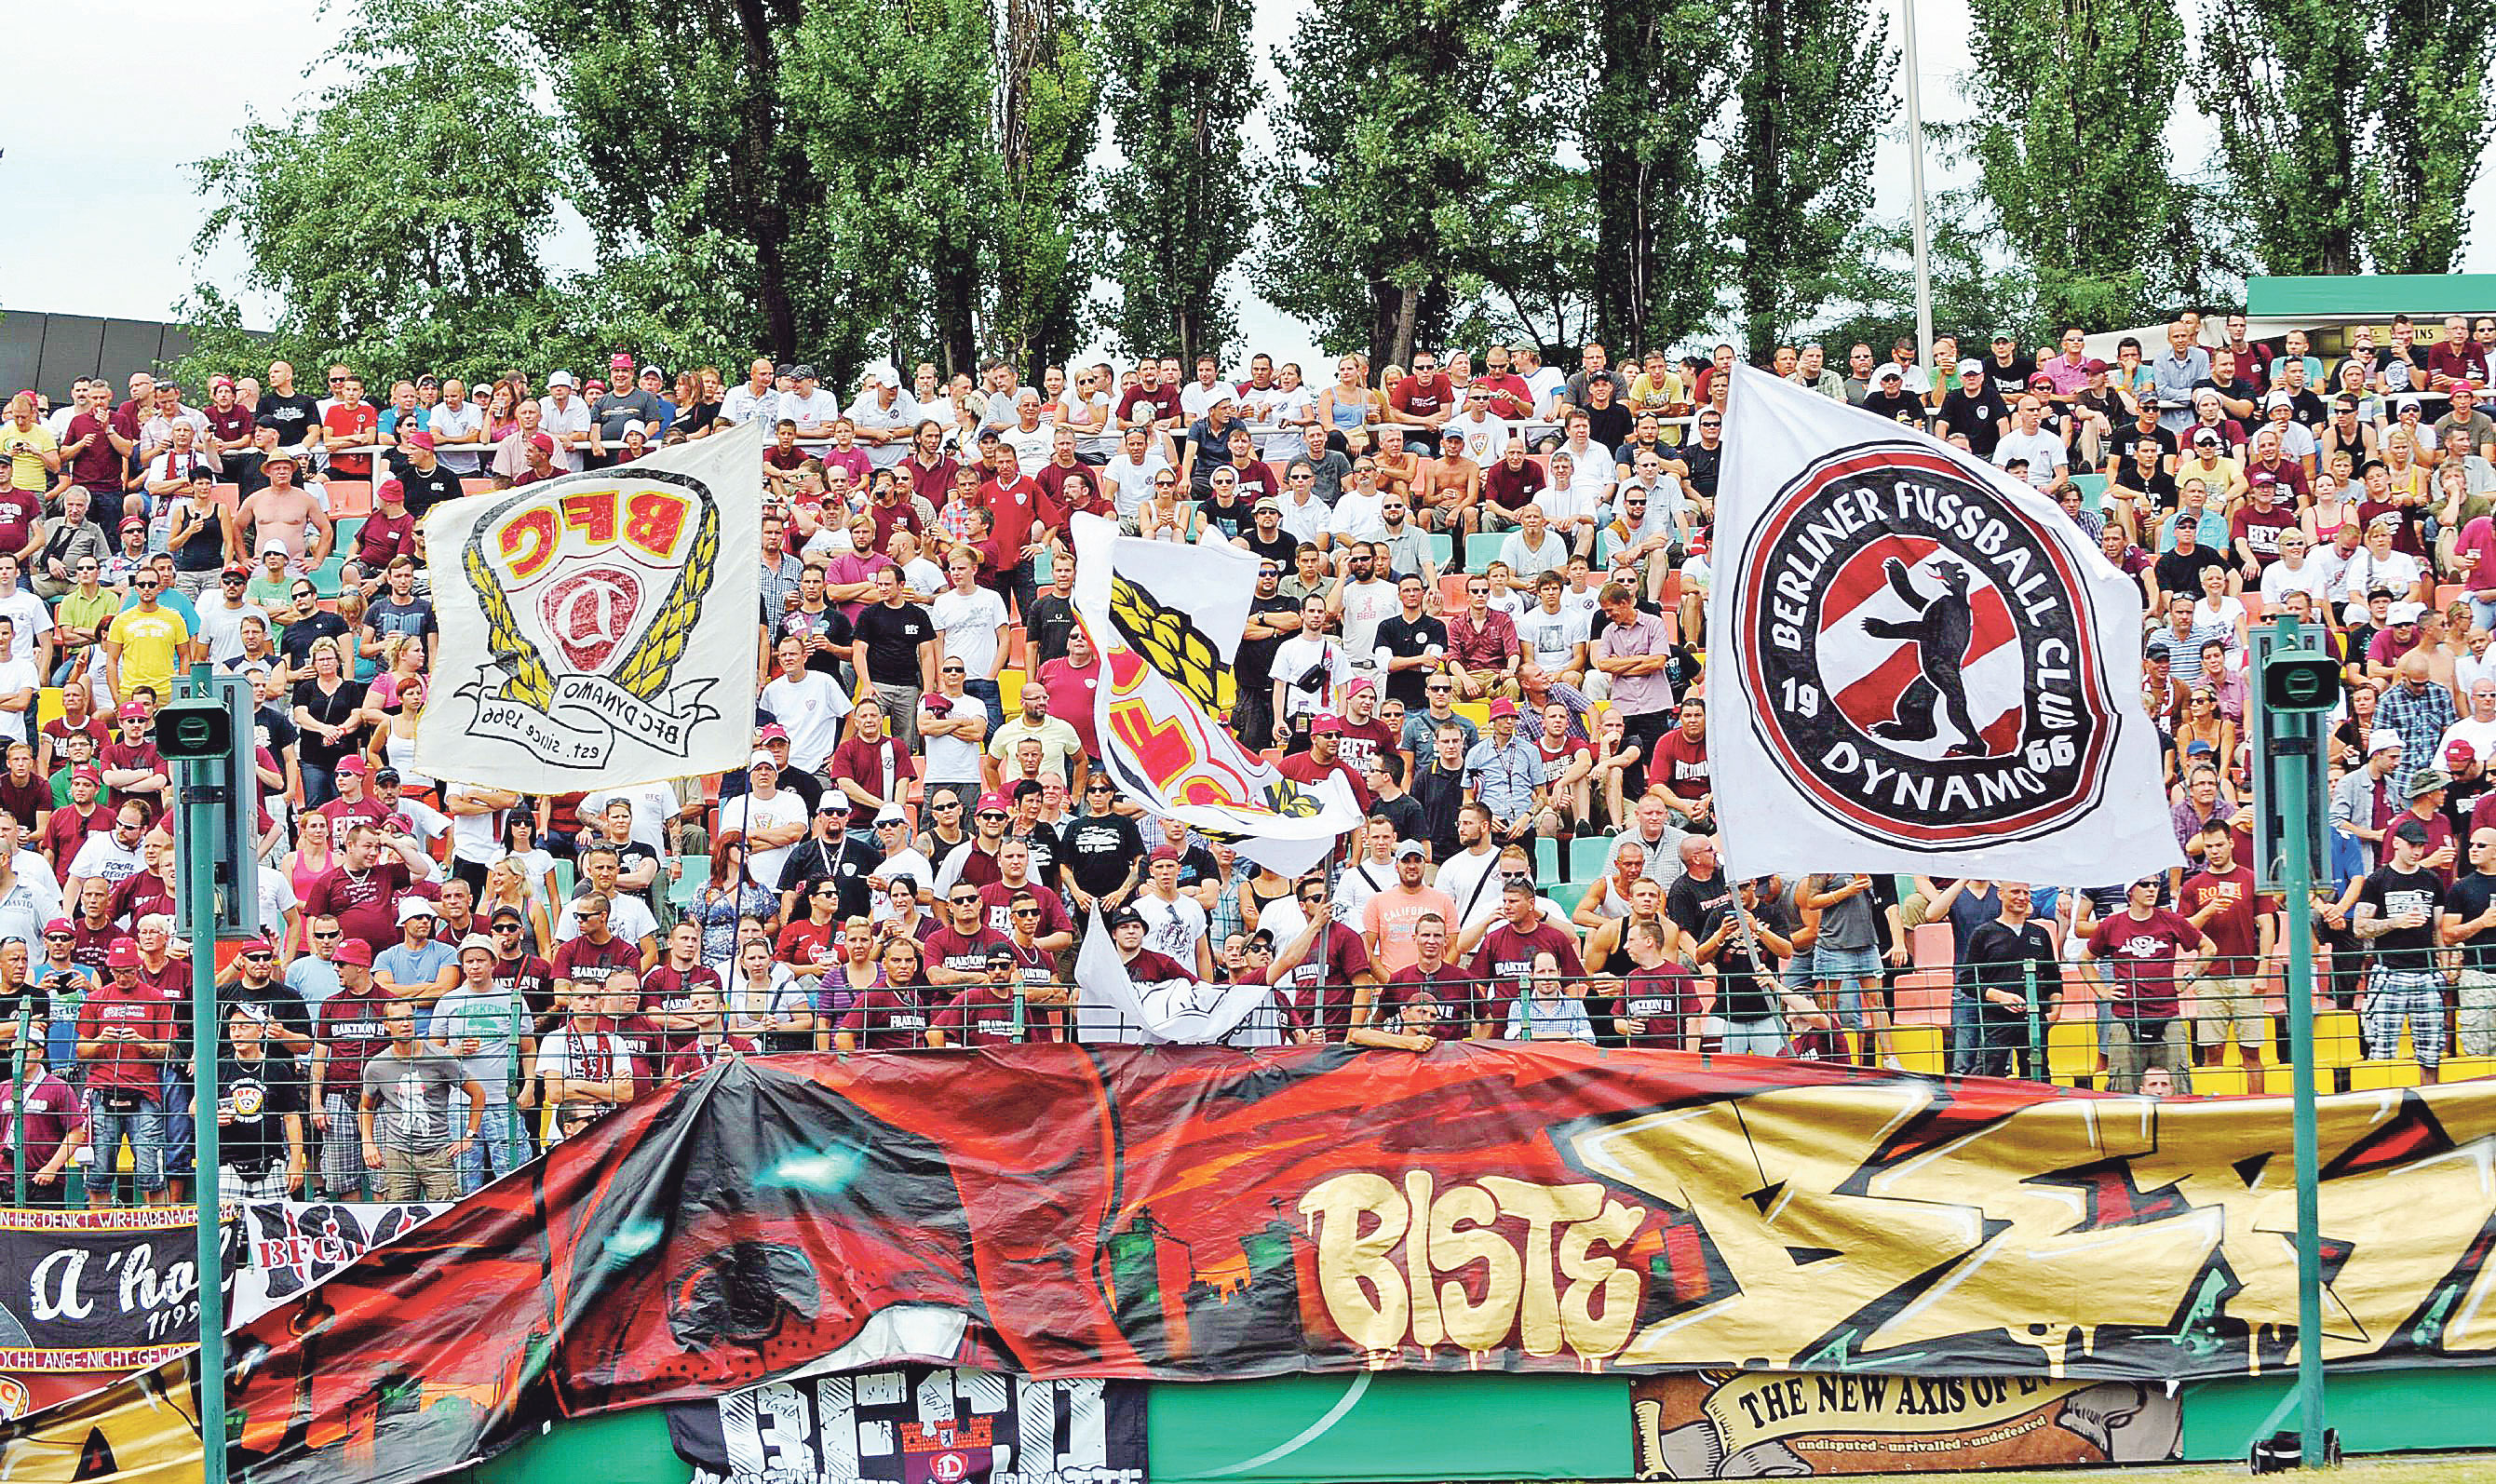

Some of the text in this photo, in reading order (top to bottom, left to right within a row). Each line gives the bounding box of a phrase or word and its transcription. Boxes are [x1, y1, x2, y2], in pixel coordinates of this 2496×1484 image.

[1772, 487, 1889, 651] BERLINER
[1894, 481, 2047, 627] FUSSBALL
[1780, 677, 1819, 719] 19
[1337, 739, 1377, 757] BFC
[2026, 735, 2076, 774] 66
[1820, 741, 2046, 812] DYNAMO
[99, 1212, 127, 1228] WIR
[1298, 1169, 1646, 1370] BISTE
[34, 1351, 83, 1370] LANGE
[88, 1350, 130, 1369] NICHT
[1738, 1380, 1808, 1429] THE
[1818, 1373, 1888, 1414] NEW
[1894, 1374, 1966, 1417] AXIS
[1796, 1415, 2047, 1453] undisputed unrivalled undefeated
